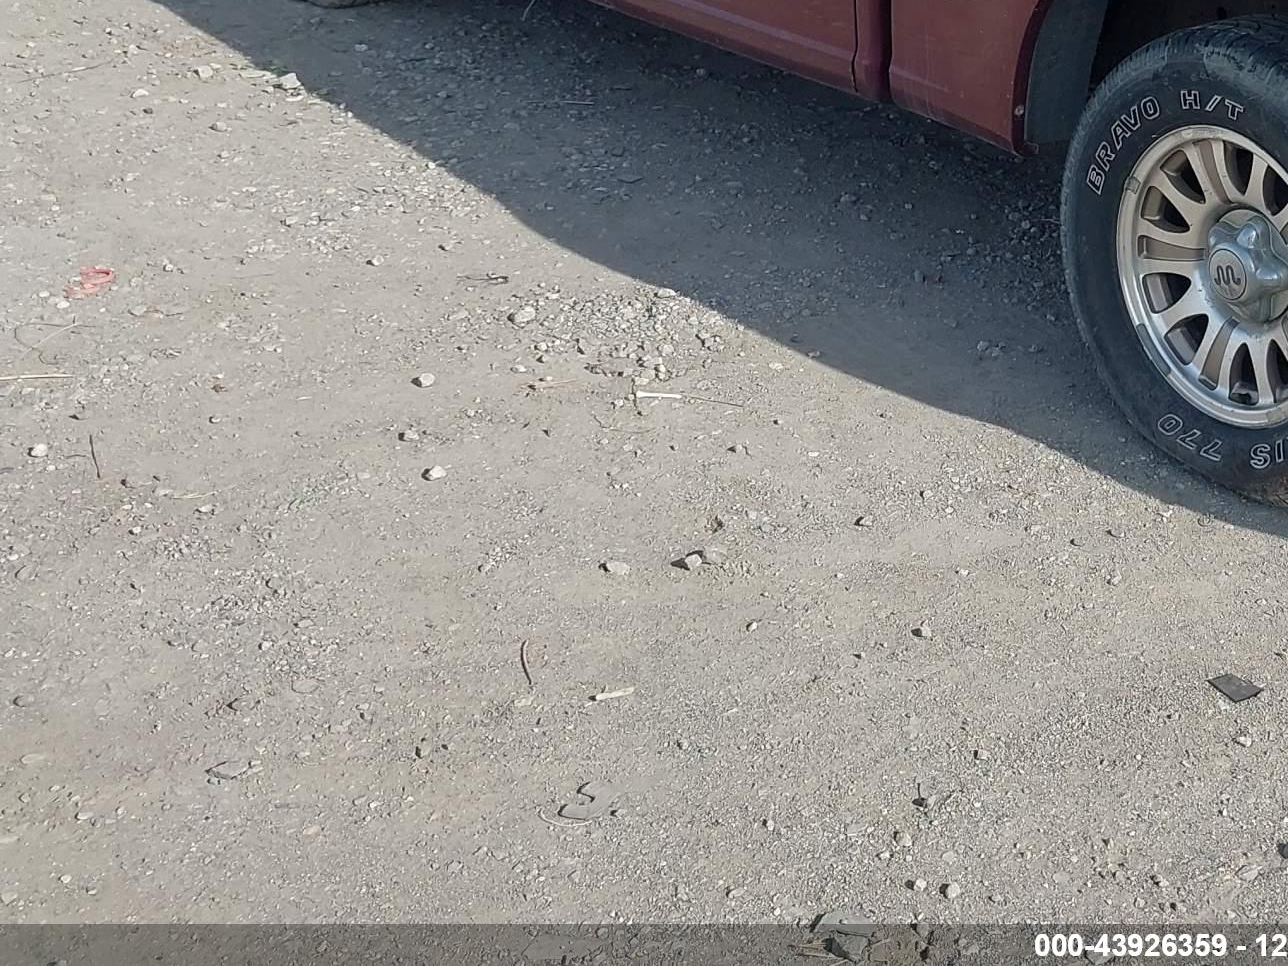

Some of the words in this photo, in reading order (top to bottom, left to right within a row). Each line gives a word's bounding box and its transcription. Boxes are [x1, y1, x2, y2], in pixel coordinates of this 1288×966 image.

[1086, 95, 1160, 196] BRAVO
[1180, 90, 1244, 121] H/T
[1157, 413, 1222, 463] 770
